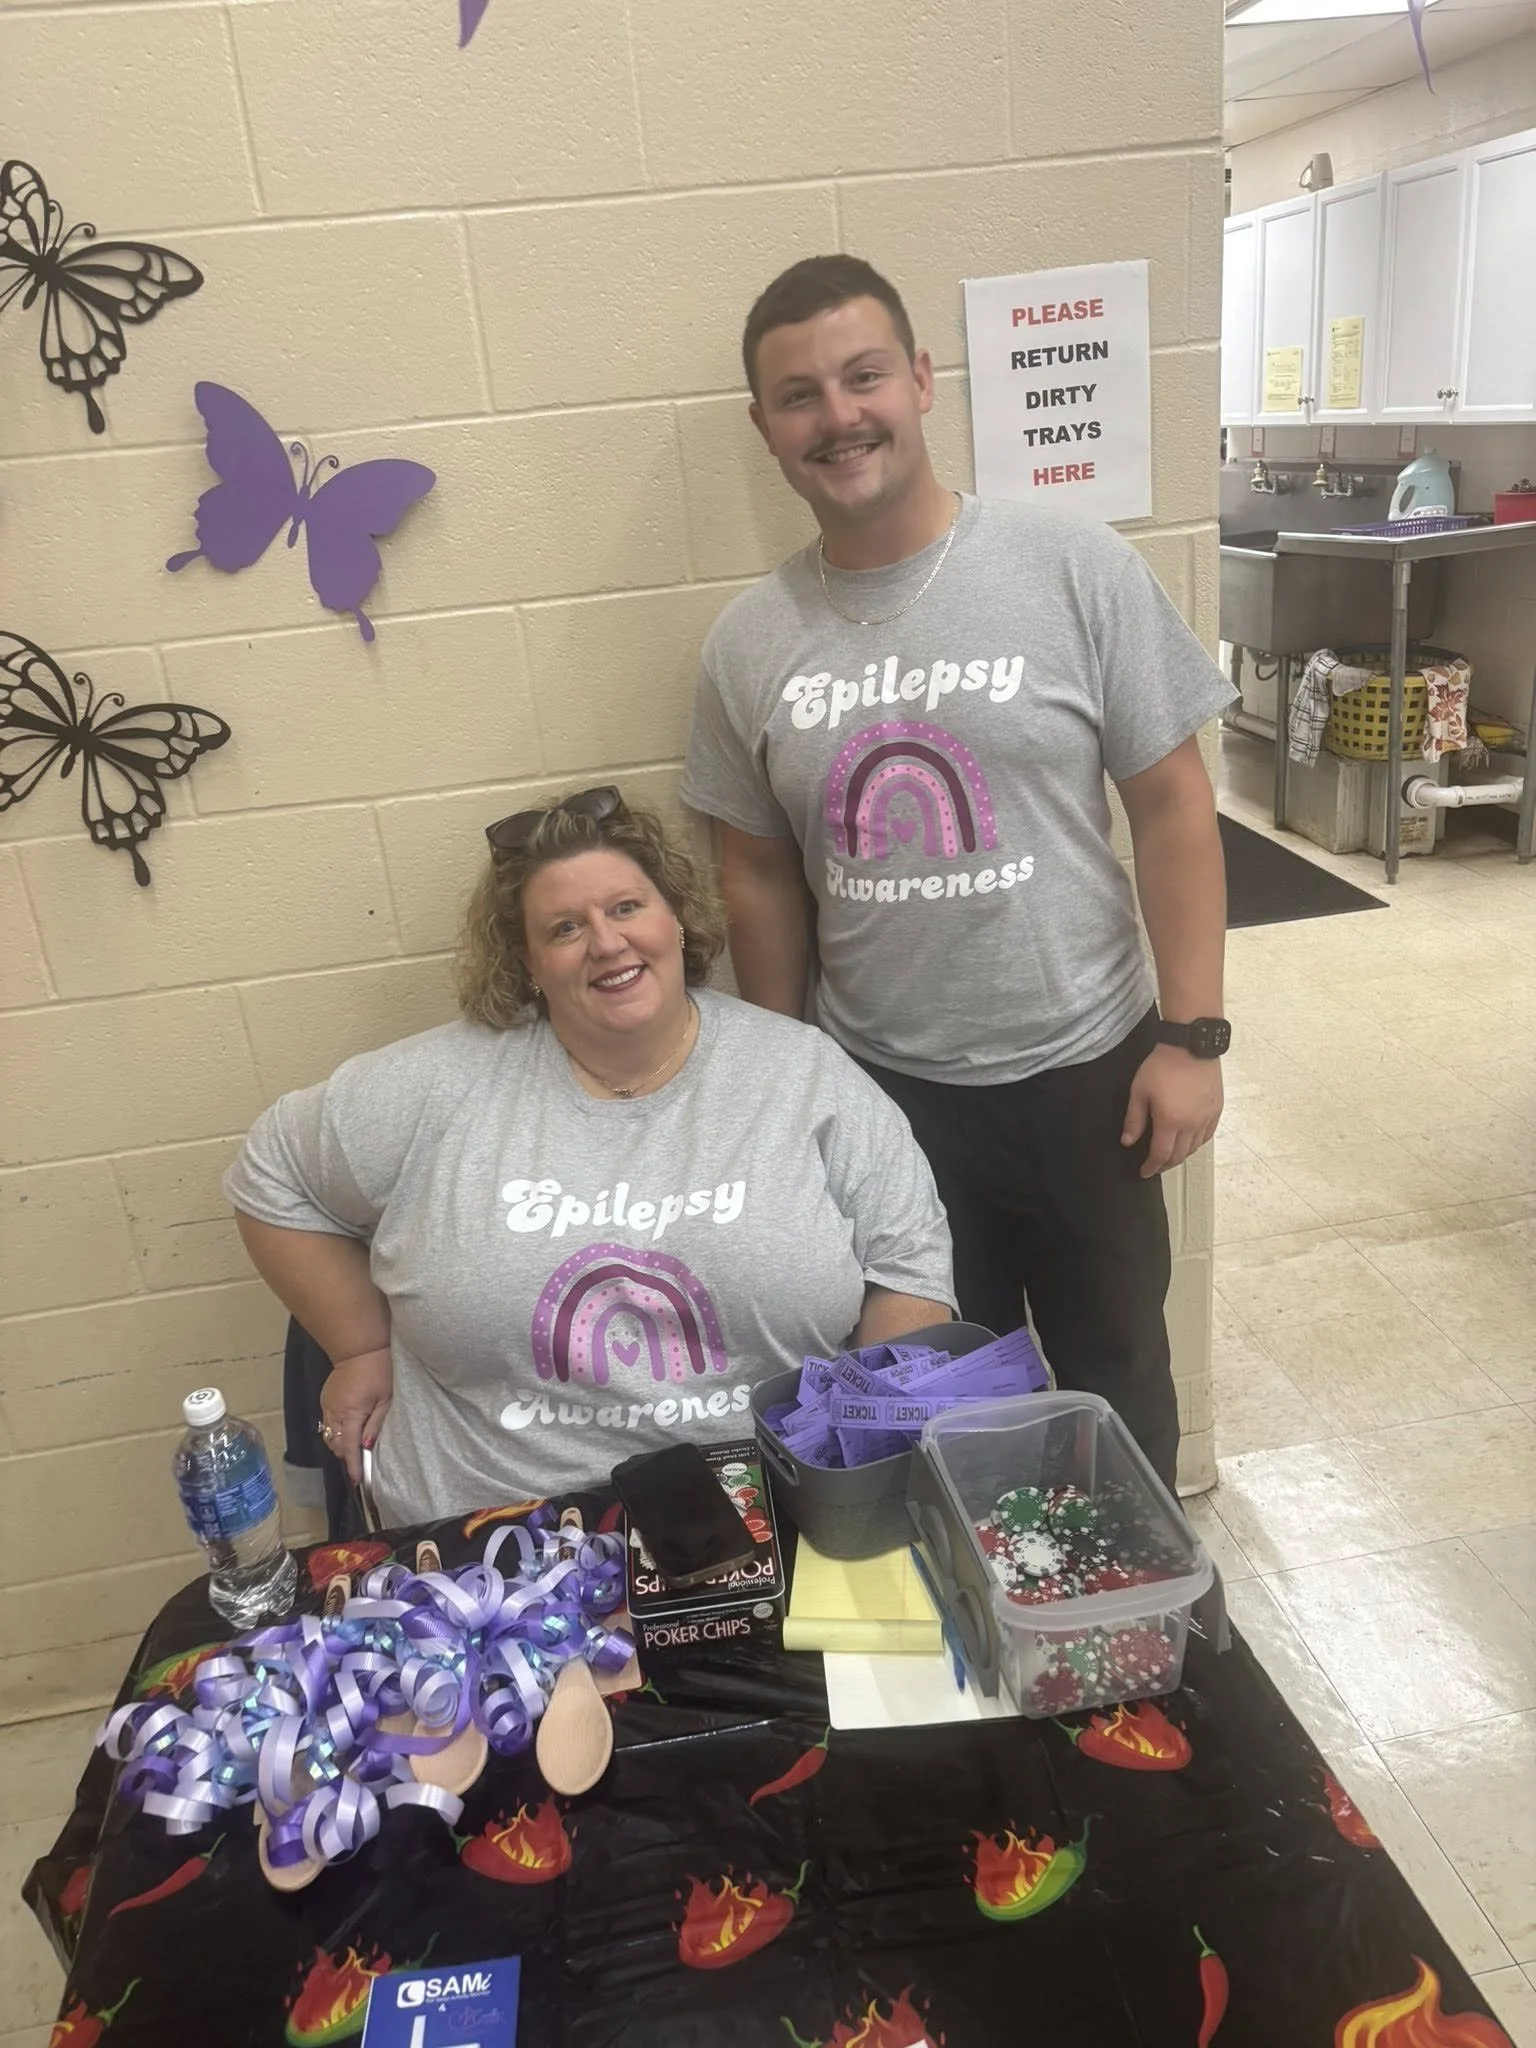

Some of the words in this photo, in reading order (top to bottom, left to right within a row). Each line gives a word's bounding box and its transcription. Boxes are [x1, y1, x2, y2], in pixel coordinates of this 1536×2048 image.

[1011, 298, 1104, 327] PLEASE
[1011, 340, 1109, 370] RETURN
[1025, 384, 1097, 409] DIRTY
[1023, 421, 1102, 446] TRAYS
[1033, 462, 1096, 486] HERE
[782, 655, 1025, 730] Epilepsy
[825, 855, 1035, 903] Awareness
[502, 1178, 746, 1242] Epilepsy
[841, 1366, 872, 1394] TICKET
[500, 1384, 751, 1431] Awarenes
[842, 1404, 878, 1421] TICKET
[895, 1405, 930, 1421] TICKET
[728, 1576, 776, 1591] Professional
[644, 1625, 700, 1648] POKER
[703, 1618, 751, 1640] CHIPS
